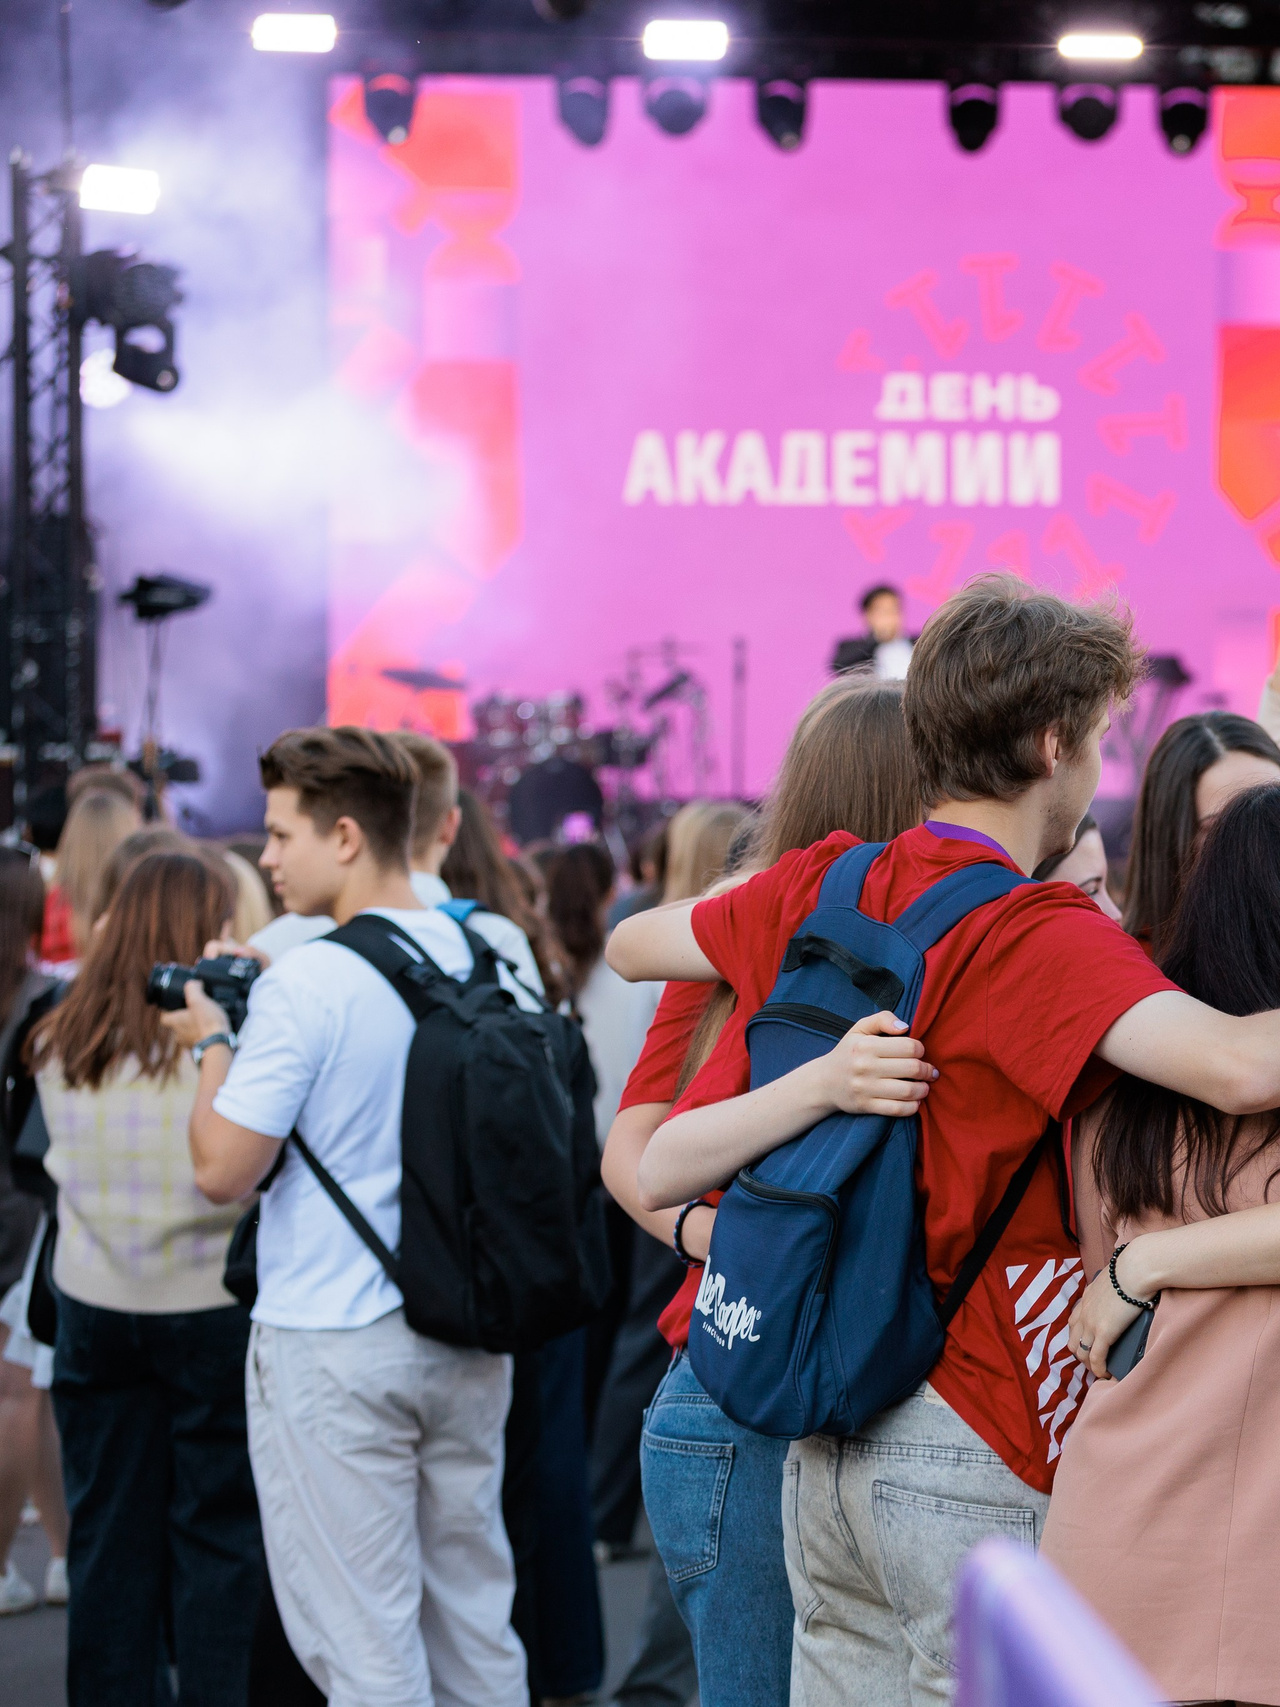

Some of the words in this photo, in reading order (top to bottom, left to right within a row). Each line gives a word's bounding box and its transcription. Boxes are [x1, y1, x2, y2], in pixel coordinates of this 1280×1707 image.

[874, 371, 1062, 422] ДЕНЬ
[622, 429, 1063, 507] АКАДЕМИИ
[714, 1272, 761, 1350] Cooper
